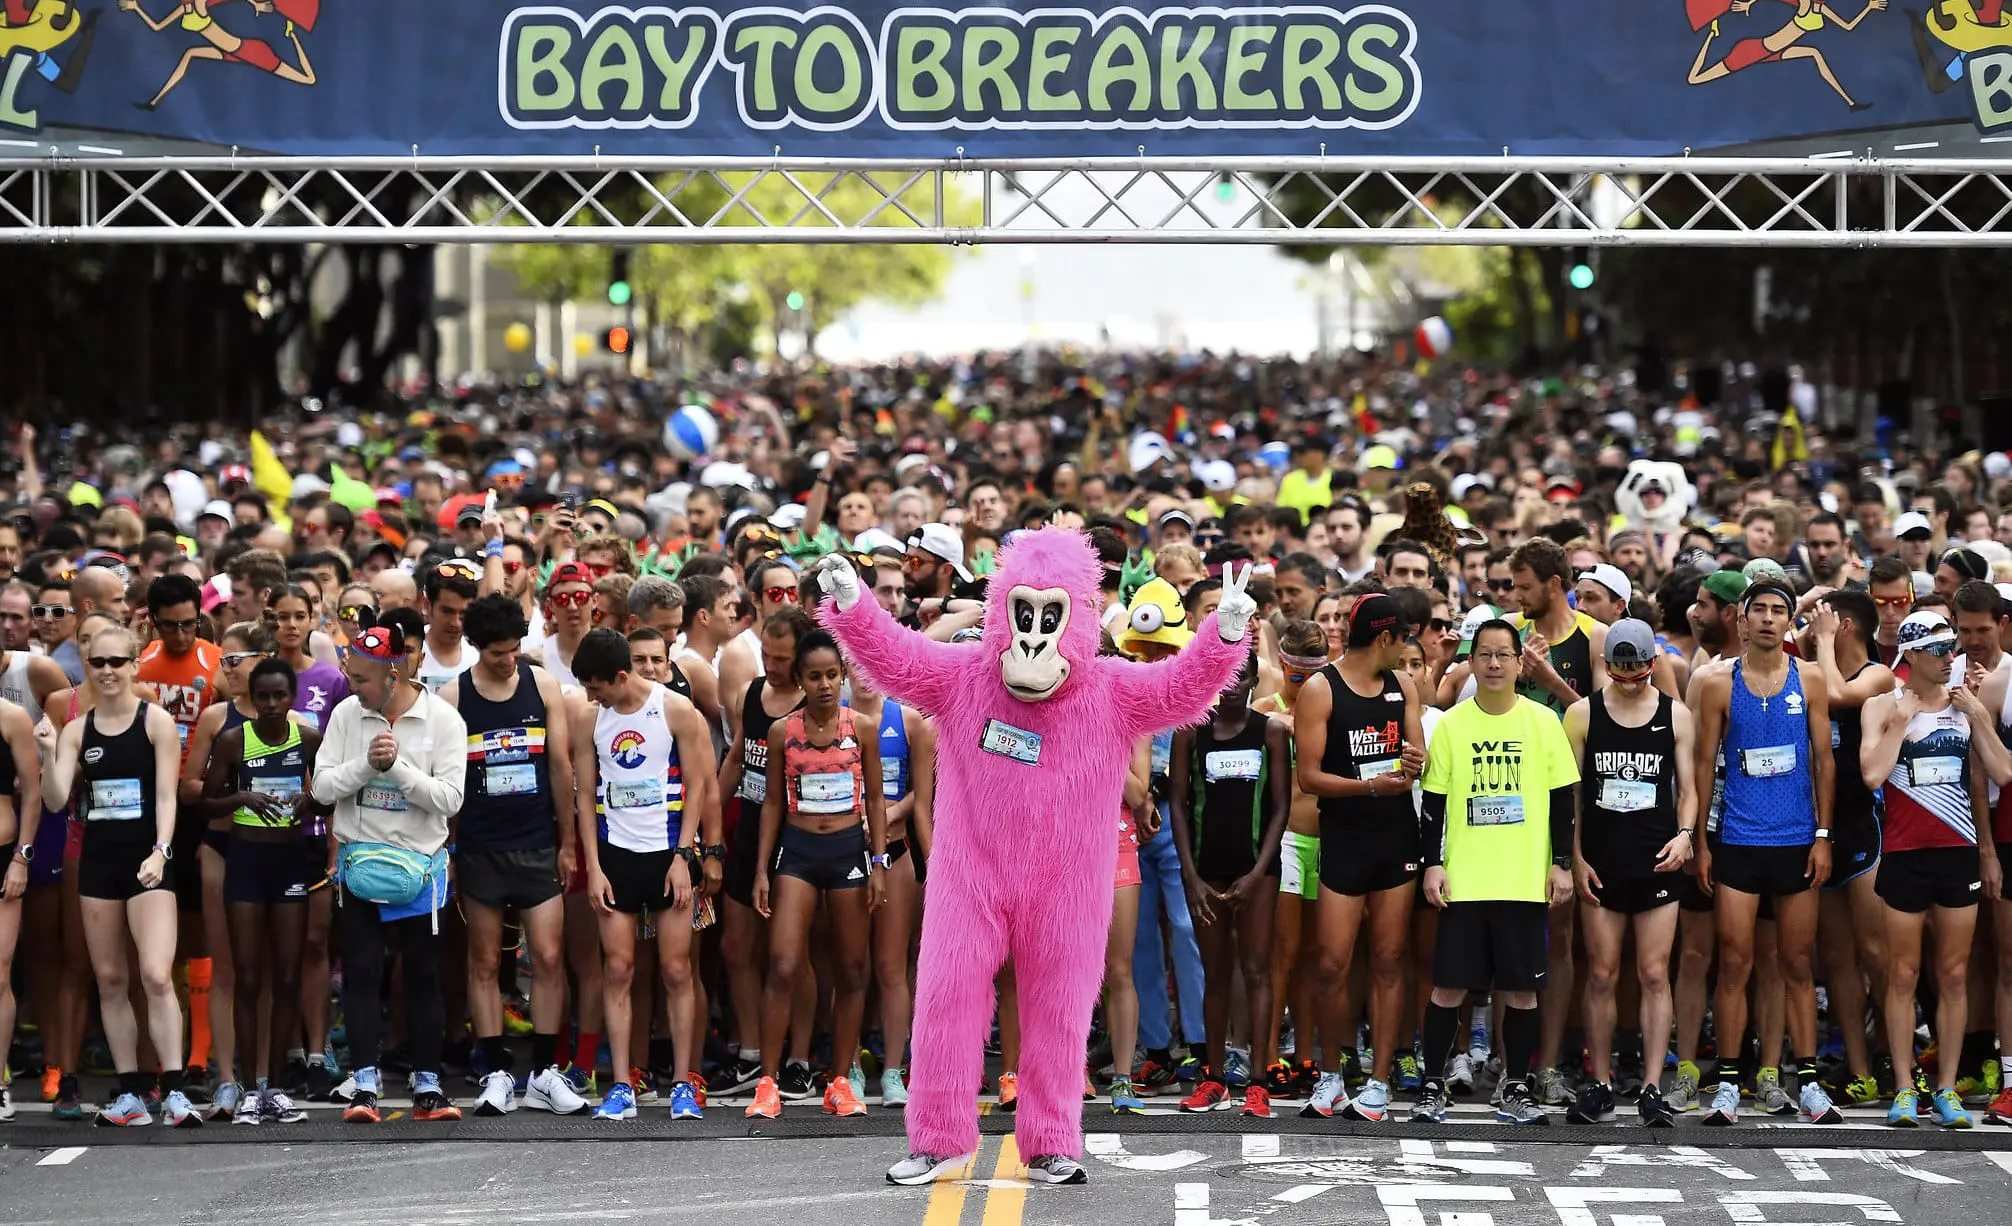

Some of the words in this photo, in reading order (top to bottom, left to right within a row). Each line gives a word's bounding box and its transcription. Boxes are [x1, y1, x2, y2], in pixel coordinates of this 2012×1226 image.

[516, 24, 706, 112] BAY
[733, 24, 863, 112] TO
[896, 24, 1404, 112] BREAKERS
[996, 734, 1017, 748] 1912
[1348, 729, 1379, 745] WEST
[744, 738, 768, 756] WEST
[1350, 742, 1386, 757] VALLEY
[1471, 741, 1522, 754] WE
[1219, 760, 1250, 769] 30299
[1594, 751, 1663, 775] GRIDLOCK
[1762, 759, 1773, 767] 25
[1471, 755, 1522, 793] RUN
[1932, 768, 1938, 776] 7
[502, 777, 512, 785] 27
[626, 791, 636, 799] 19
[1617, 791, 1629, 799] 37
[1480, 807, 1506, 816] 9505
